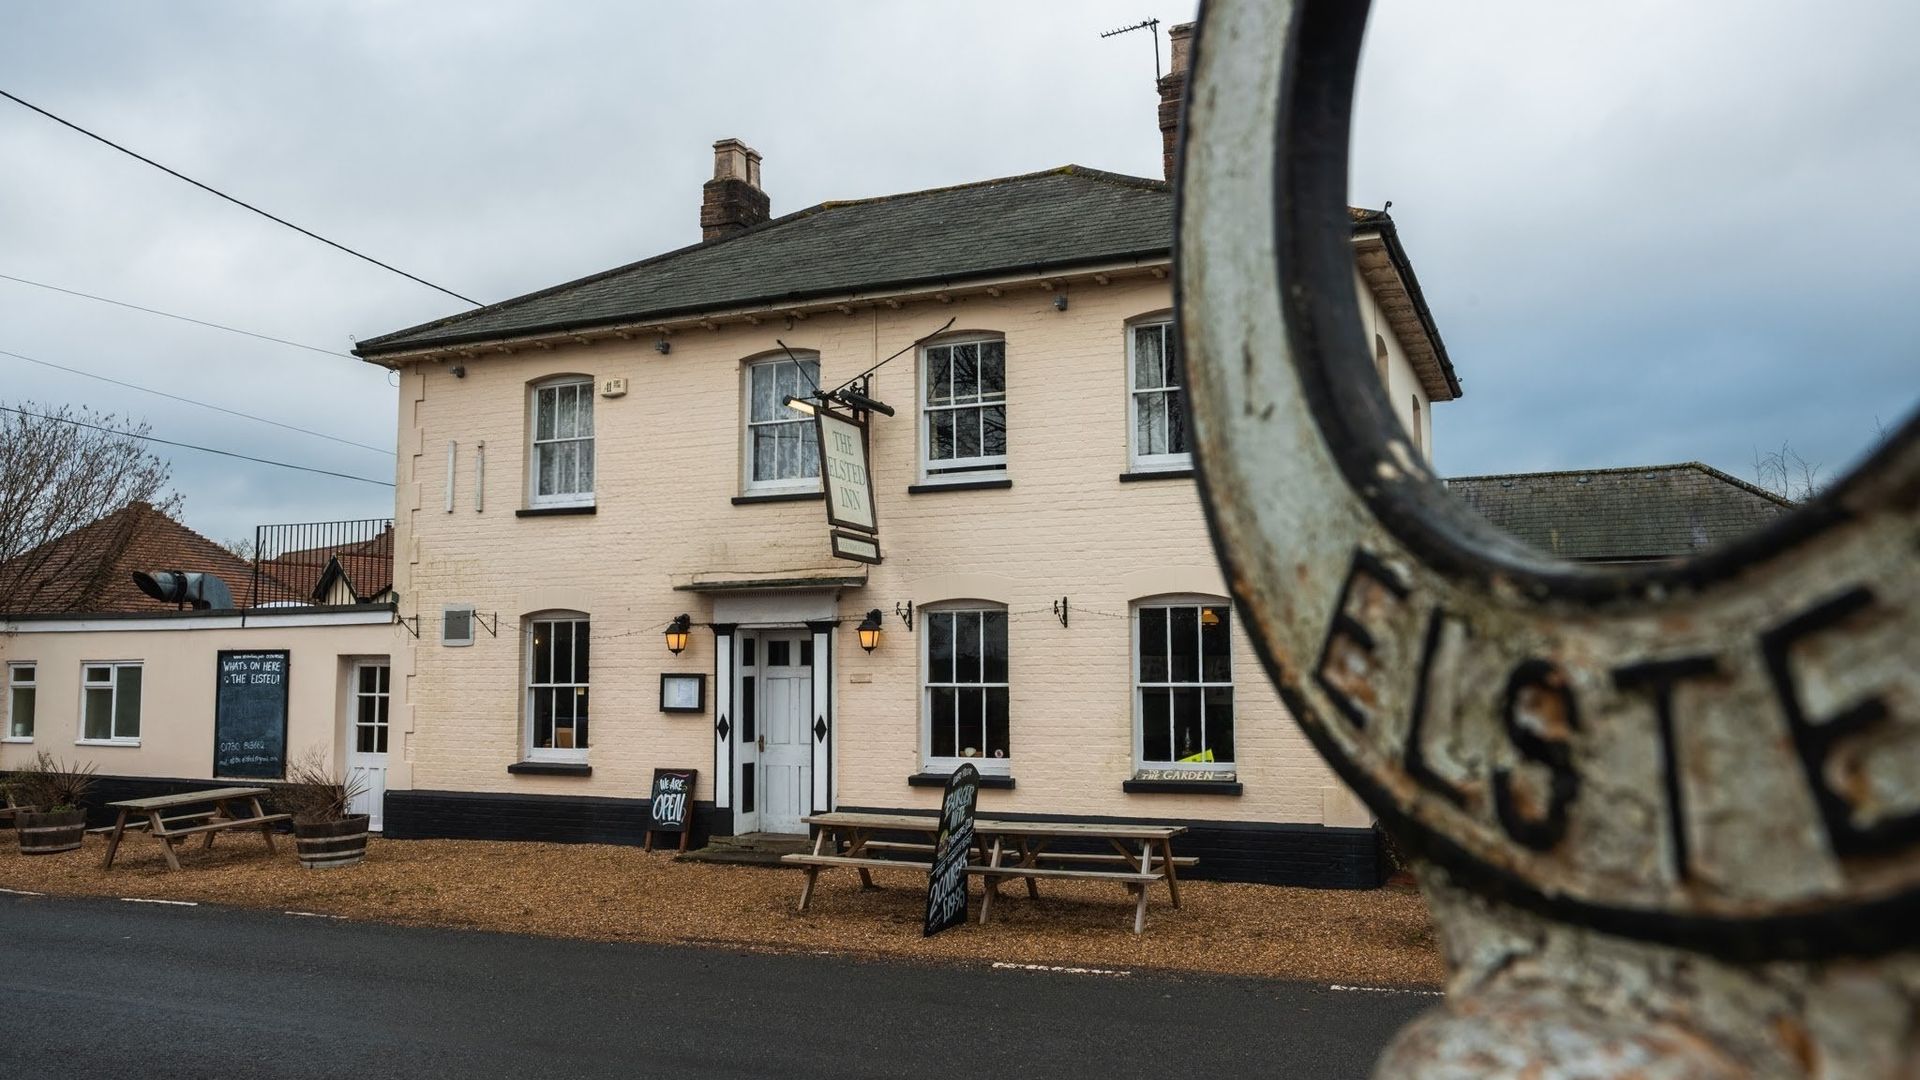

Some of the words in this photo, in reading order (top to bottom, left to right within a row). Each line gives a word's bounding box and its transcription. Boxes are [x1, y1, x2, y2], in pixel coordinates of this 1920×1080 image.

[832, 430, 854, 456] THE
[827, 456, 866, 486] ELSTED
[839, 486, 861, 512] INN
[250, 661, 261, 671] ON
[262, 661, 281, 672] HERE
[231, 673, 247, 684] THE
[660, 778, 669, 790] WE
[670, 778, 684, 791] ARE
[1163, 770, 1214, 780] GARDEN
[652, 793, 685, 821] OPEN
